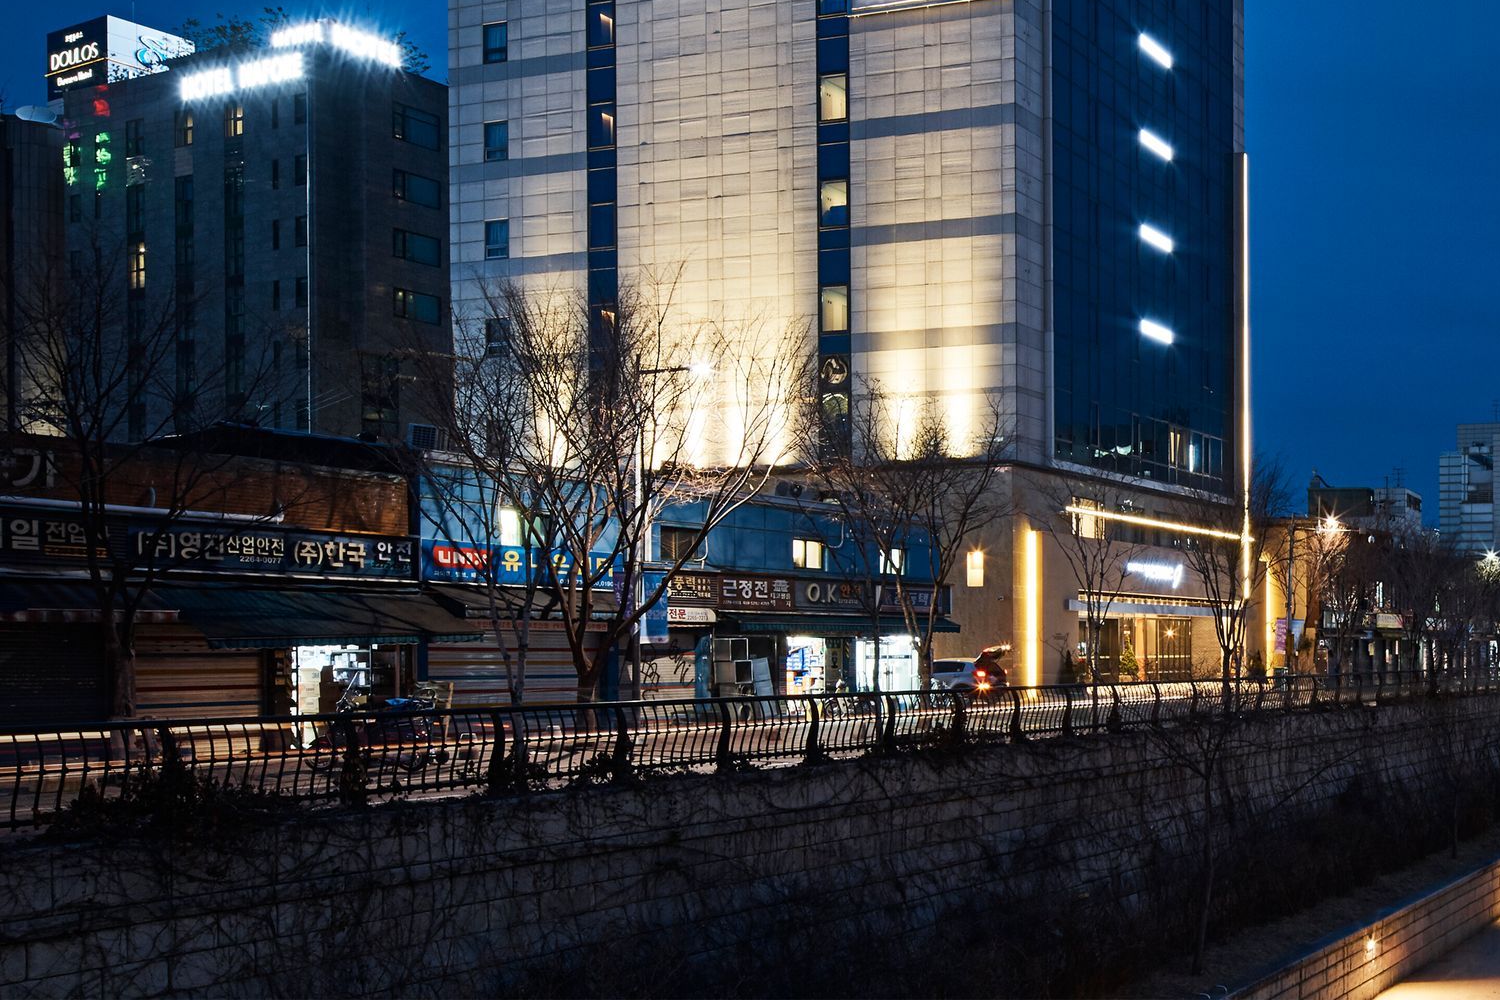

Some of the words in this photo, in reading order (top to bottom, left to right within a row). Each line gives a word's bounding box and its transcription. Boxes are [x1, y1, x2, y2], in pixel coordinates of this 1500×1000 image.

[50, 41, 99, 71] DOULOS
[181, 68, 232, 101] HOTEL
[1, 448, 58, 489] 가
[0, 517, 40, 551] 일
[226, 535, 285, 557] 산업안전
[294, 540, 367, 569] (주)한국
[377, 541, 412, 562] 안전
[722, 579, 769, 600] 근정전
[806, 582, 837, 603] O.K
[669, 608, 687, 620] 전문
